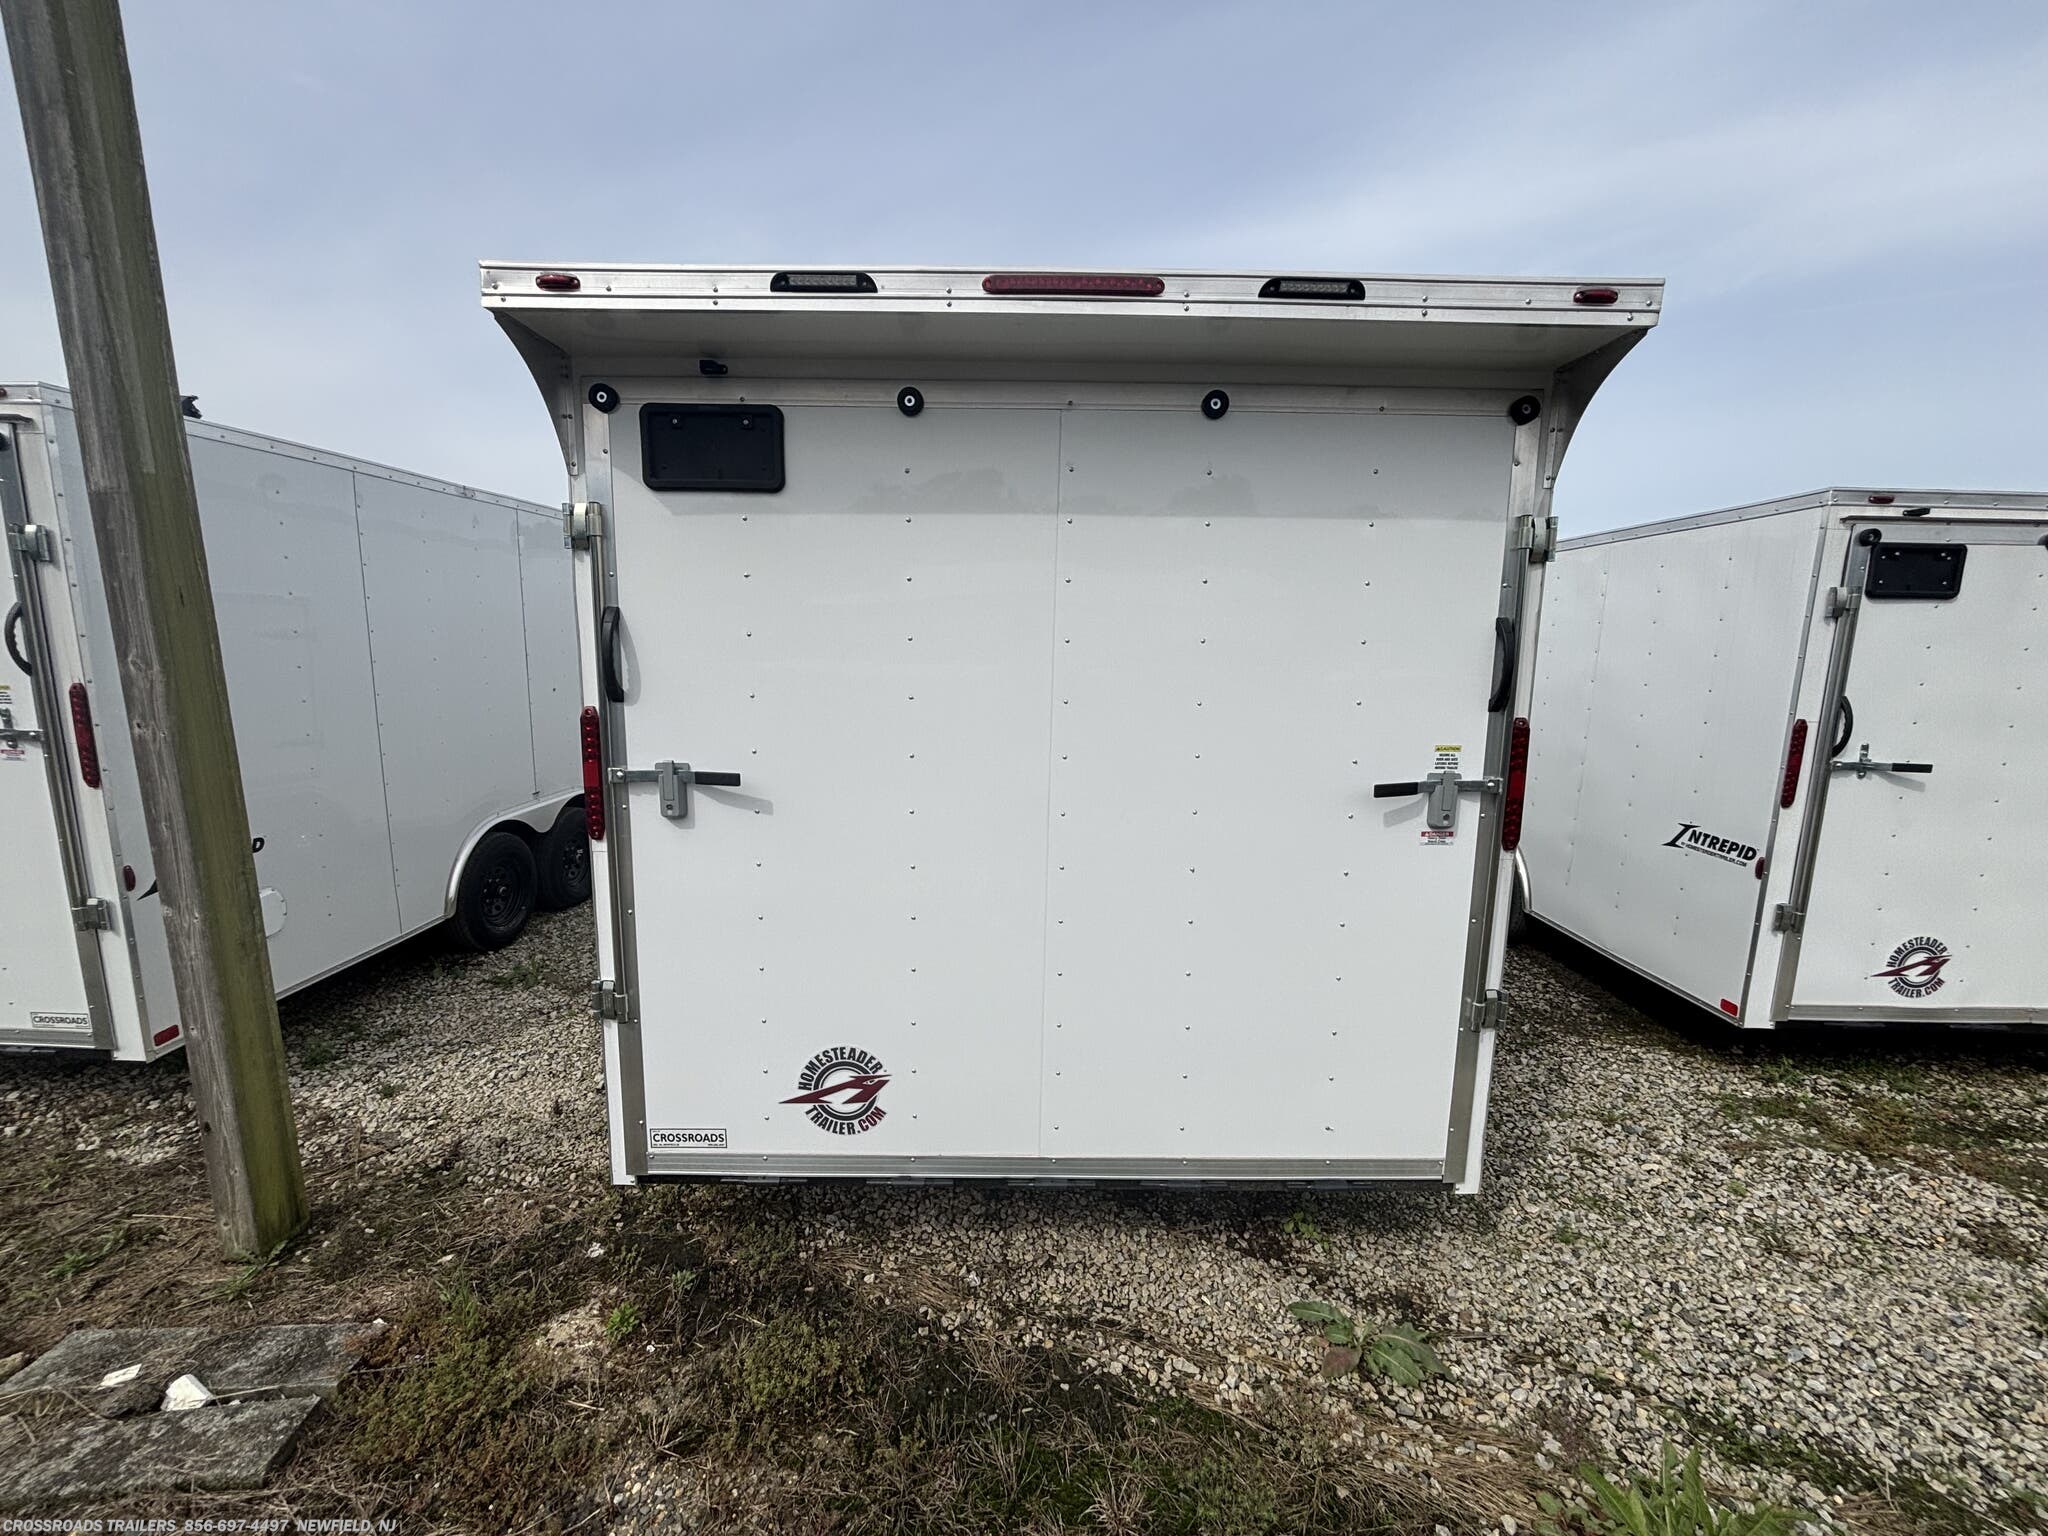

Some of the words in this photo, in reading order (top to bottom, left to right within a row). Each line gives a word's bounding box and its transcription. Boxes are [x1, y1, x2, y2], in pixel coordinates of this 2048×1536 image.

[1661, 822, 1757, 861] INTREPID
[1886, 936, 1948, 968] HOMESTEADER
[1887, 977, 1945, 998] TRAILER.COM
[33, 1016, 88, 1025] CROSSROADS
[798, 1046, 883, 1091] HOMESTEADER
[805, 1104, 887, 1135] TRAILER.COM
[652, 1133, 725, 1143] CROSSROADS
